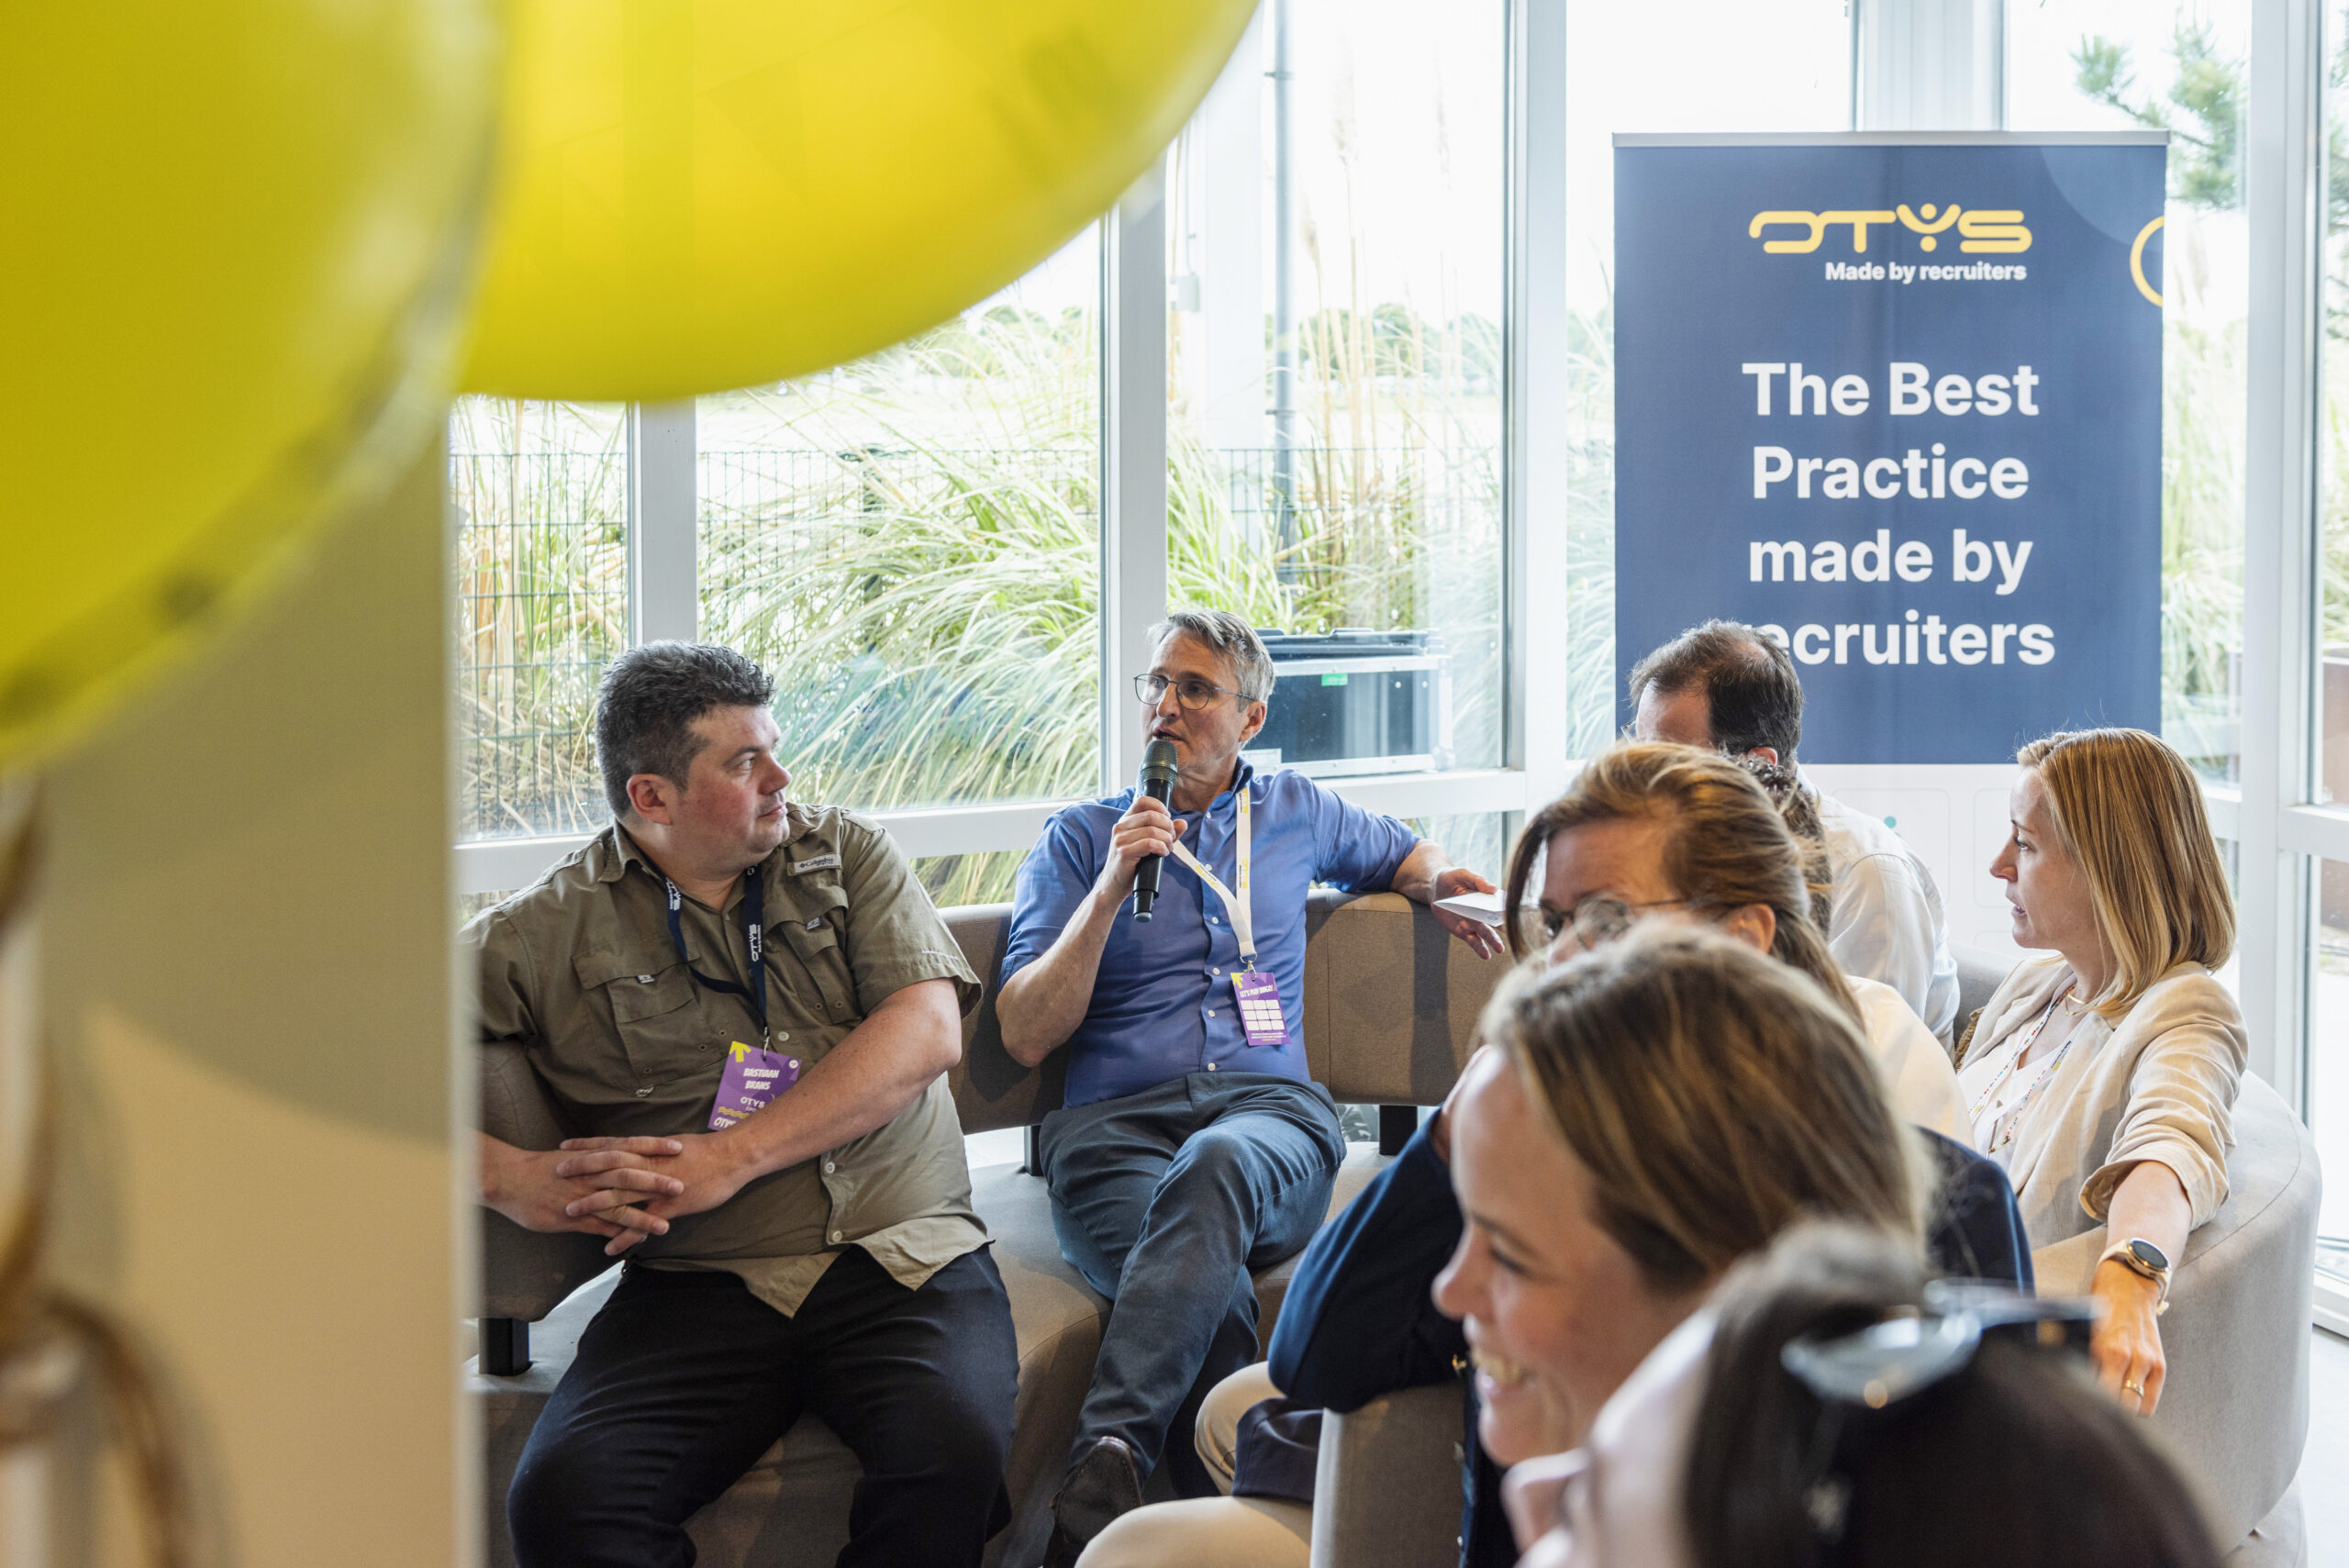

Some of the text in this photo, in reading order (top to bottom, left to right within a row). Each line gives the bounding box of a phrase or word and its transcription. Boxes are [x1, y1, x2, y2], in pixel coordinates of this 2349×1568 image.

[1748, 203, 2033, 254] OTYS
[1825, 261, 2028, 285] Made by recruiters
[1742, 362, 2040, 417] The Best
[1753, 442, 2029, 500] Practice
[1750, 528, 2033, 595] made by
[1741, 608, 2055, 665] ecruiters
[740, 1096, 765, 1108] OTYS
